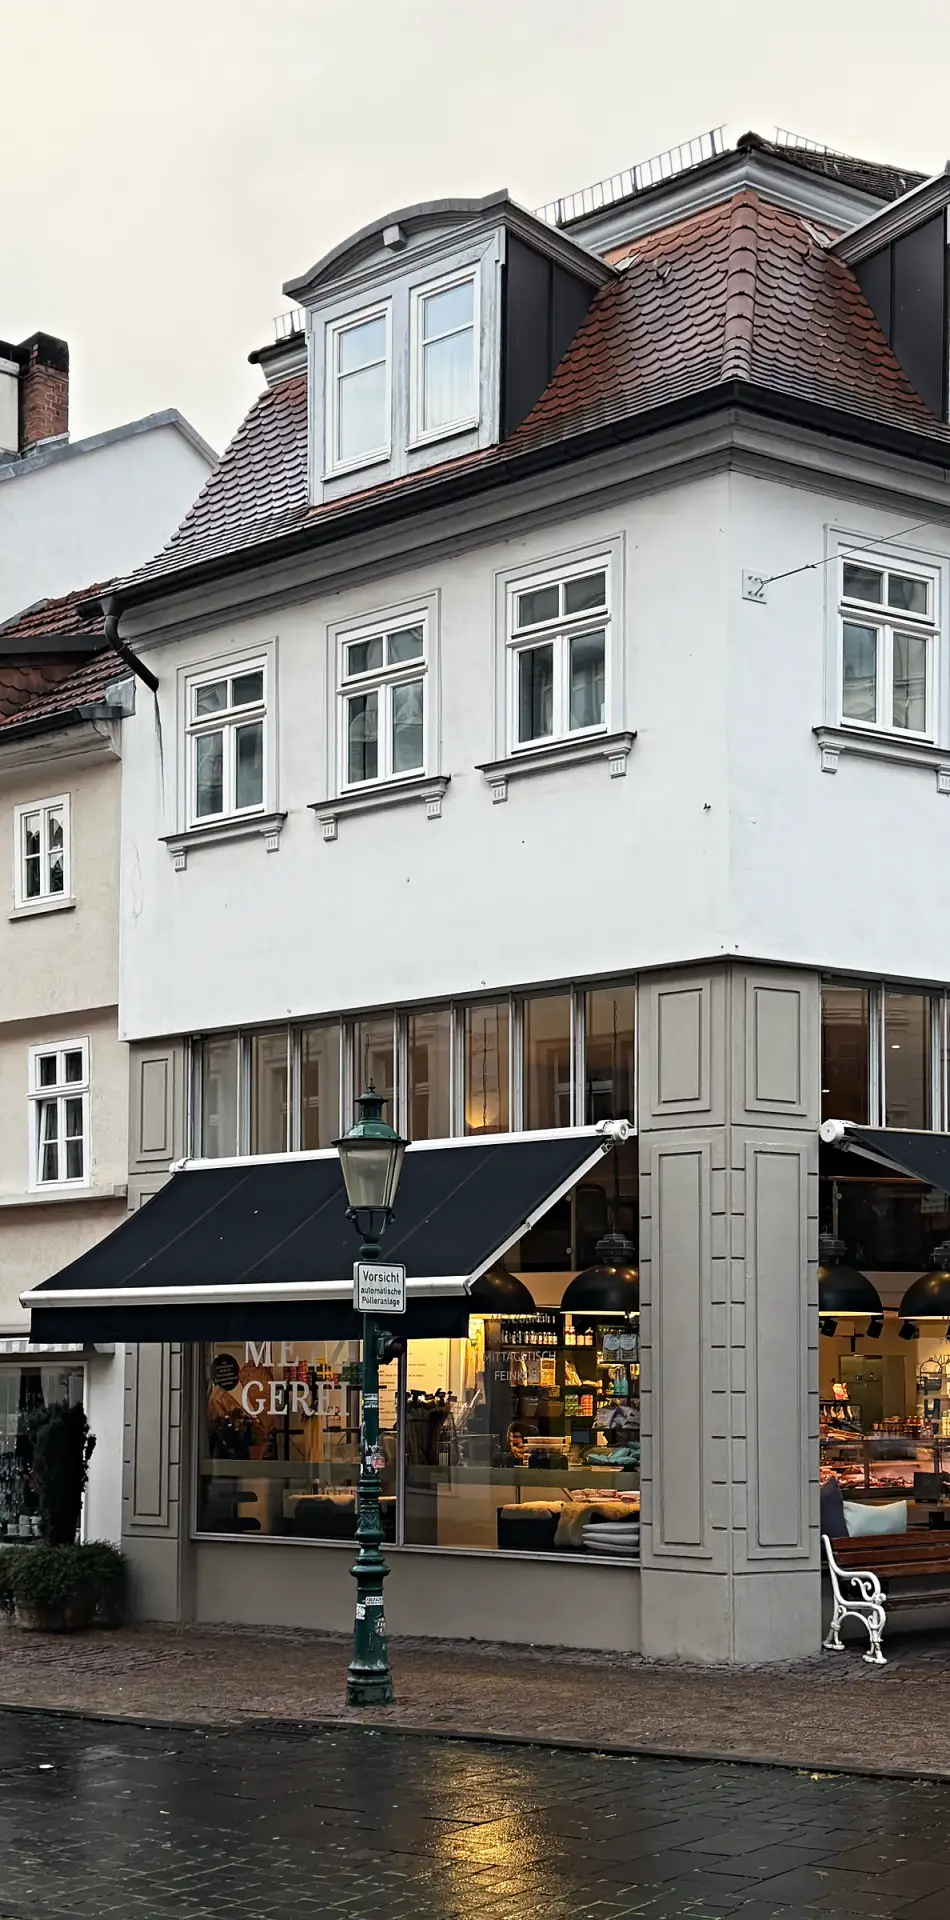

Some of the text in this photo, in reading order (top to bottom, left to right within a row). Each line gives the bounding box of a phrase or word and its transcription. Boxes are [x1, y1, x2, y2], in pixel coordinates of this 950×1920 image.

[362, 1270, 400, 1283] Vorsicht
[360, 1287, 401, 1296] automatische
[361, 1296, 400, 1307] Polleranlage
[241, 1380, 350, 1417] GEREI
